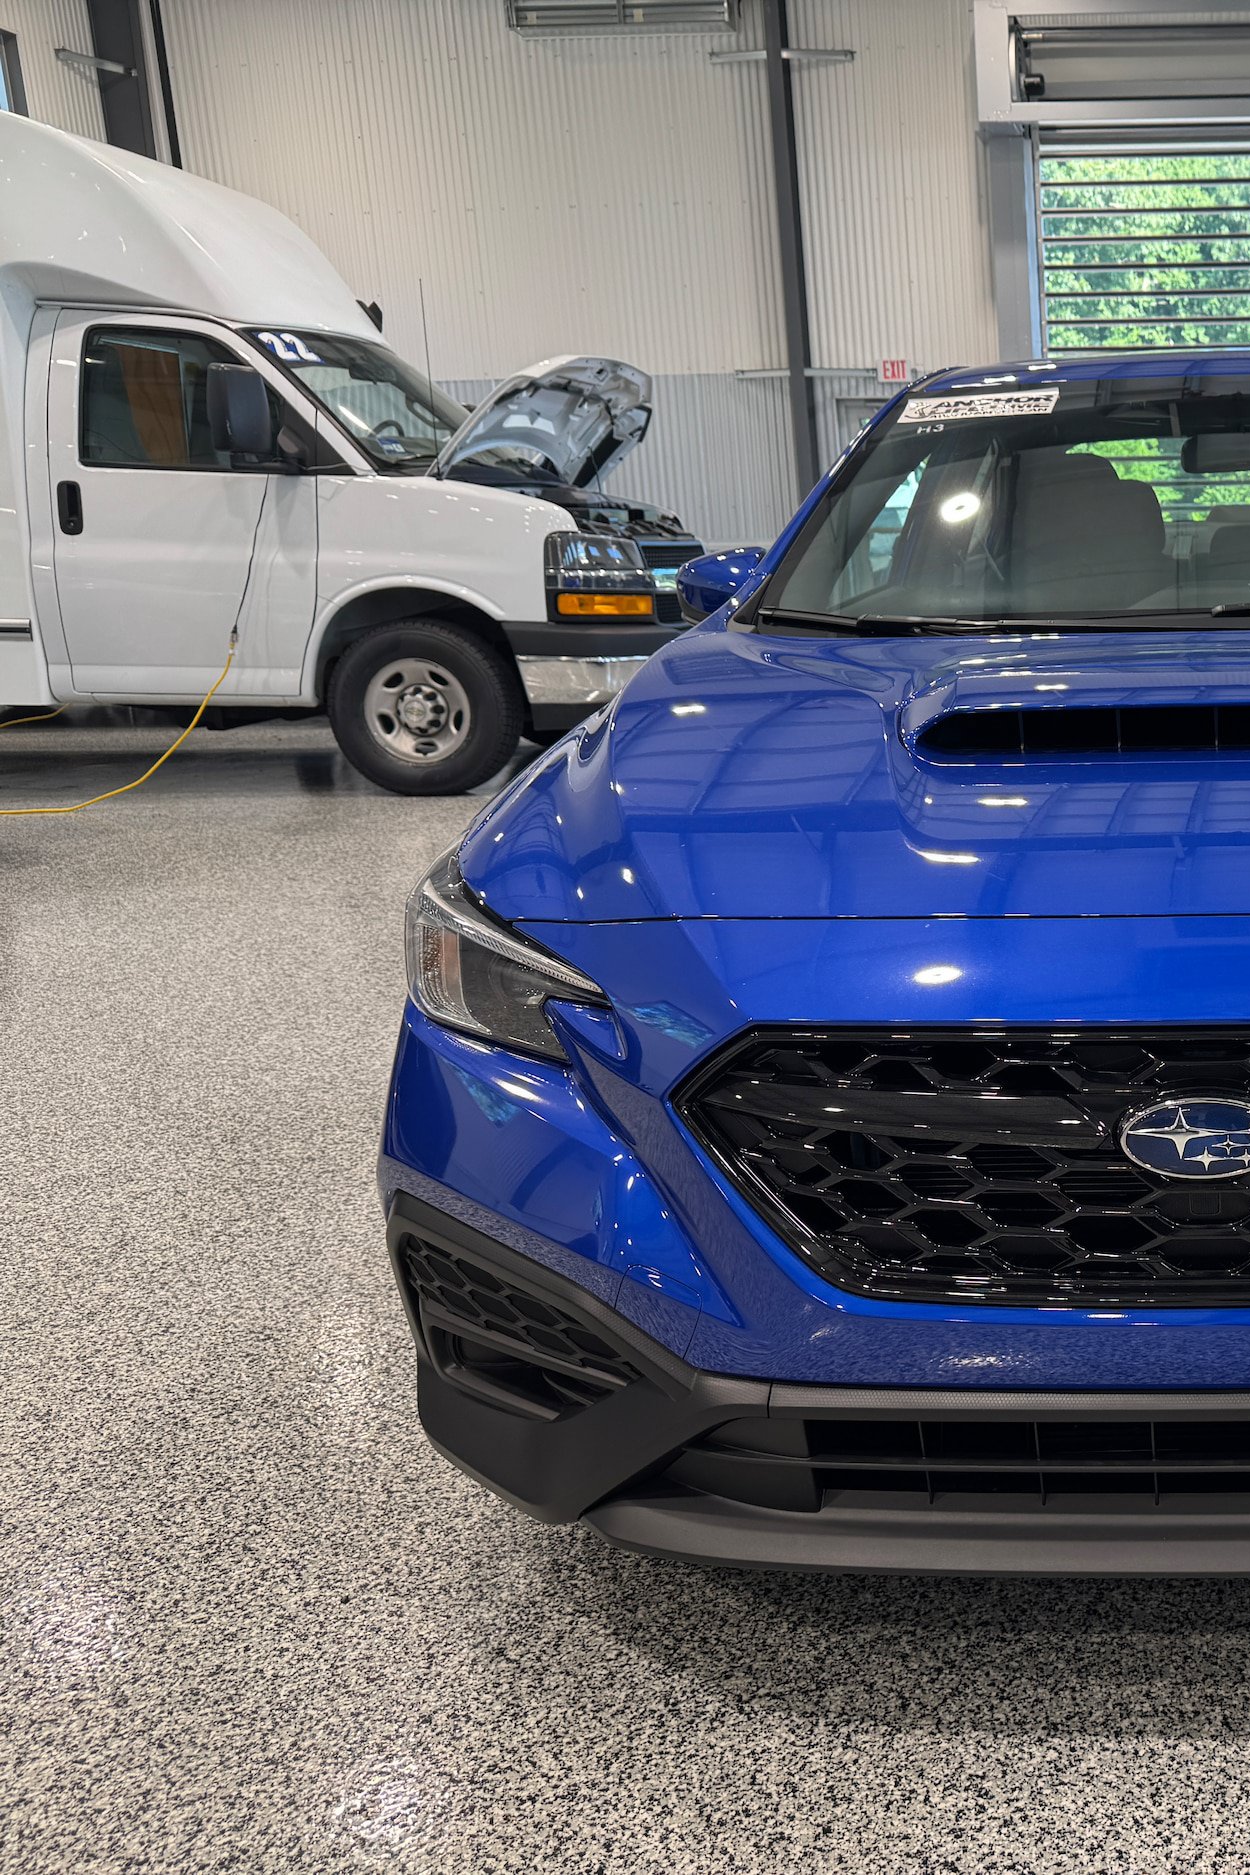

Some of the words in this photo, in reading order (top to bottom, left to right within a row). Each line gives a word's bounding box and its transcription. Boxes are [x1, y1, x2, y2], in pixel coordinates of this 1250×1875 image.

[257, 332, 322, 363] 22
[883, 360, 907, 379] EXIT
[917, 423, 945, 434] H3
